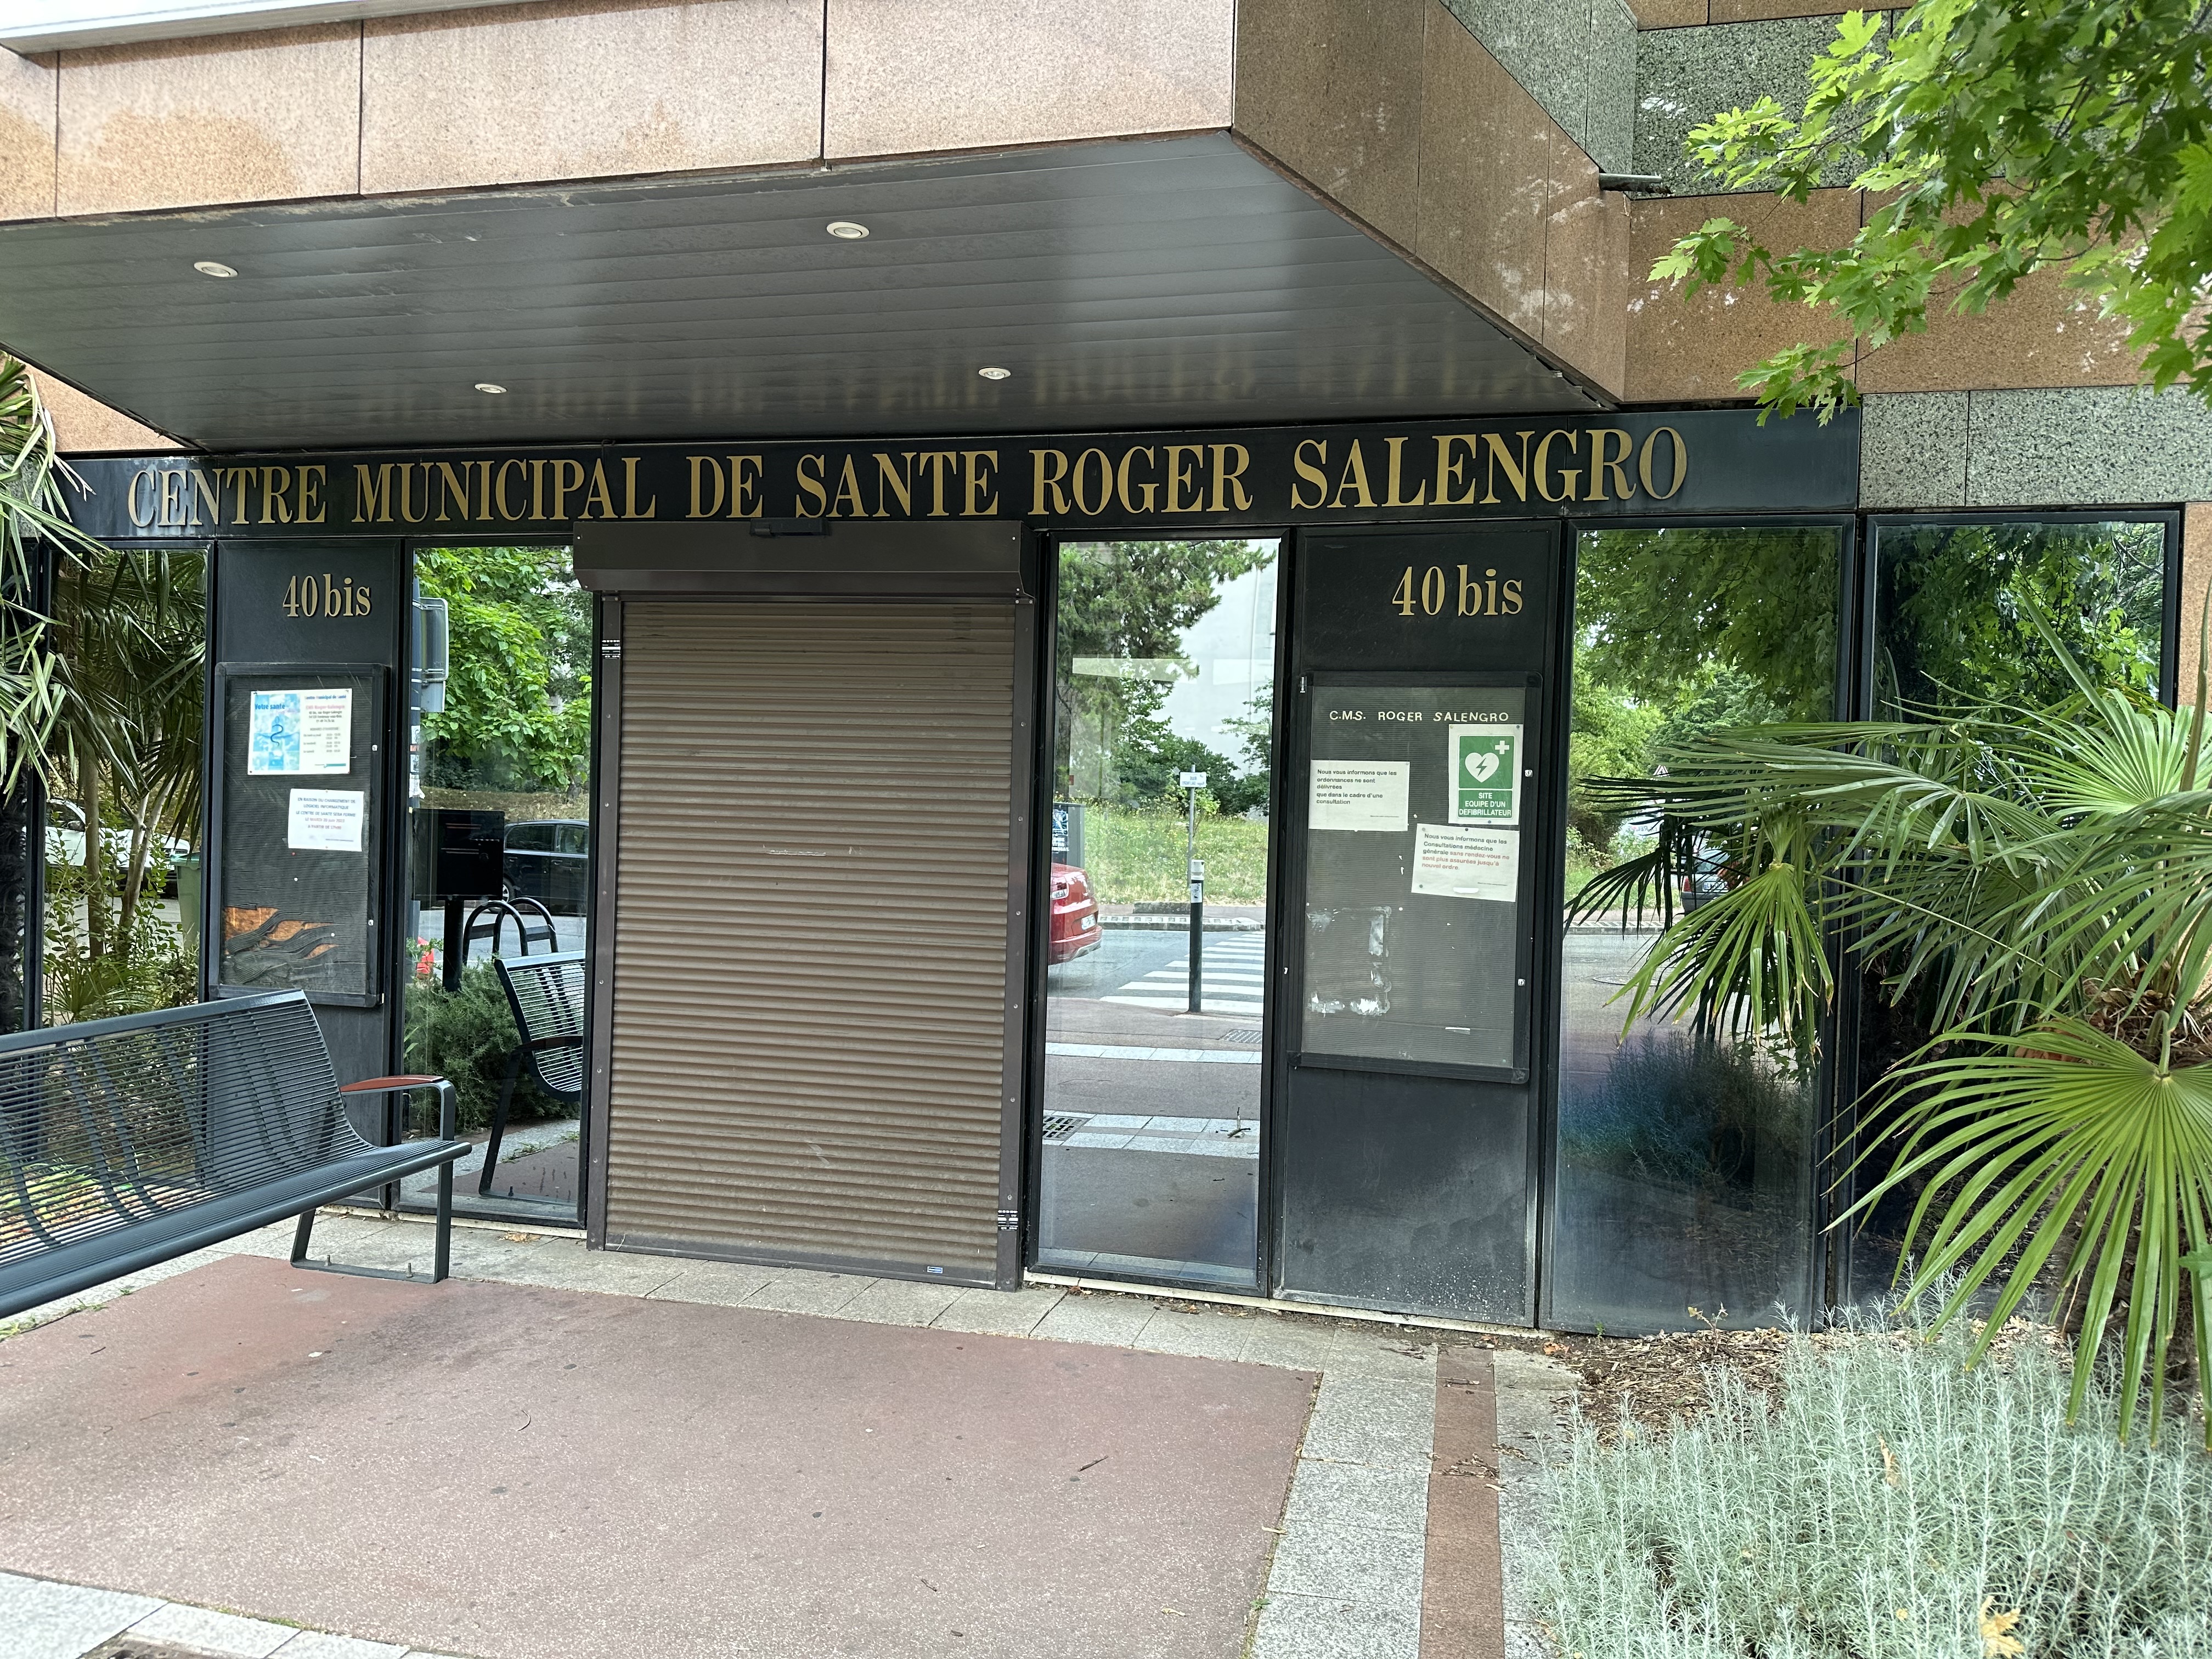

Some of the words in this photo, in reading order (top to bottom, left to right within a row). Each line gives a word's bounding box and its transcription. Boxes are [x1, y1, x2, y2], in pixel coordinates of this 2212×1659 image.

[128, 465, 326, 528] CENTRE
[352, 456, 656, 523] MUNICIPAL
[685, 454, 763, 518] DE
[795, 450, 998, 519] SANTE
[1028, 444, 1253, 517] ROGER
[1290, 426, 1688, 510] SALENGRO
[282, 575, 318, 618] 40
[323, 573, 371, 618] bis
[1392, 565, 1445, 616] 40
[1457, 564, 1523, 616] bis
[1329, 710, 1366, 721] C.M.S.
[1378, 711, 1423, 722] ROGER
[1432, 712, 1509, 723] SALENGRO
